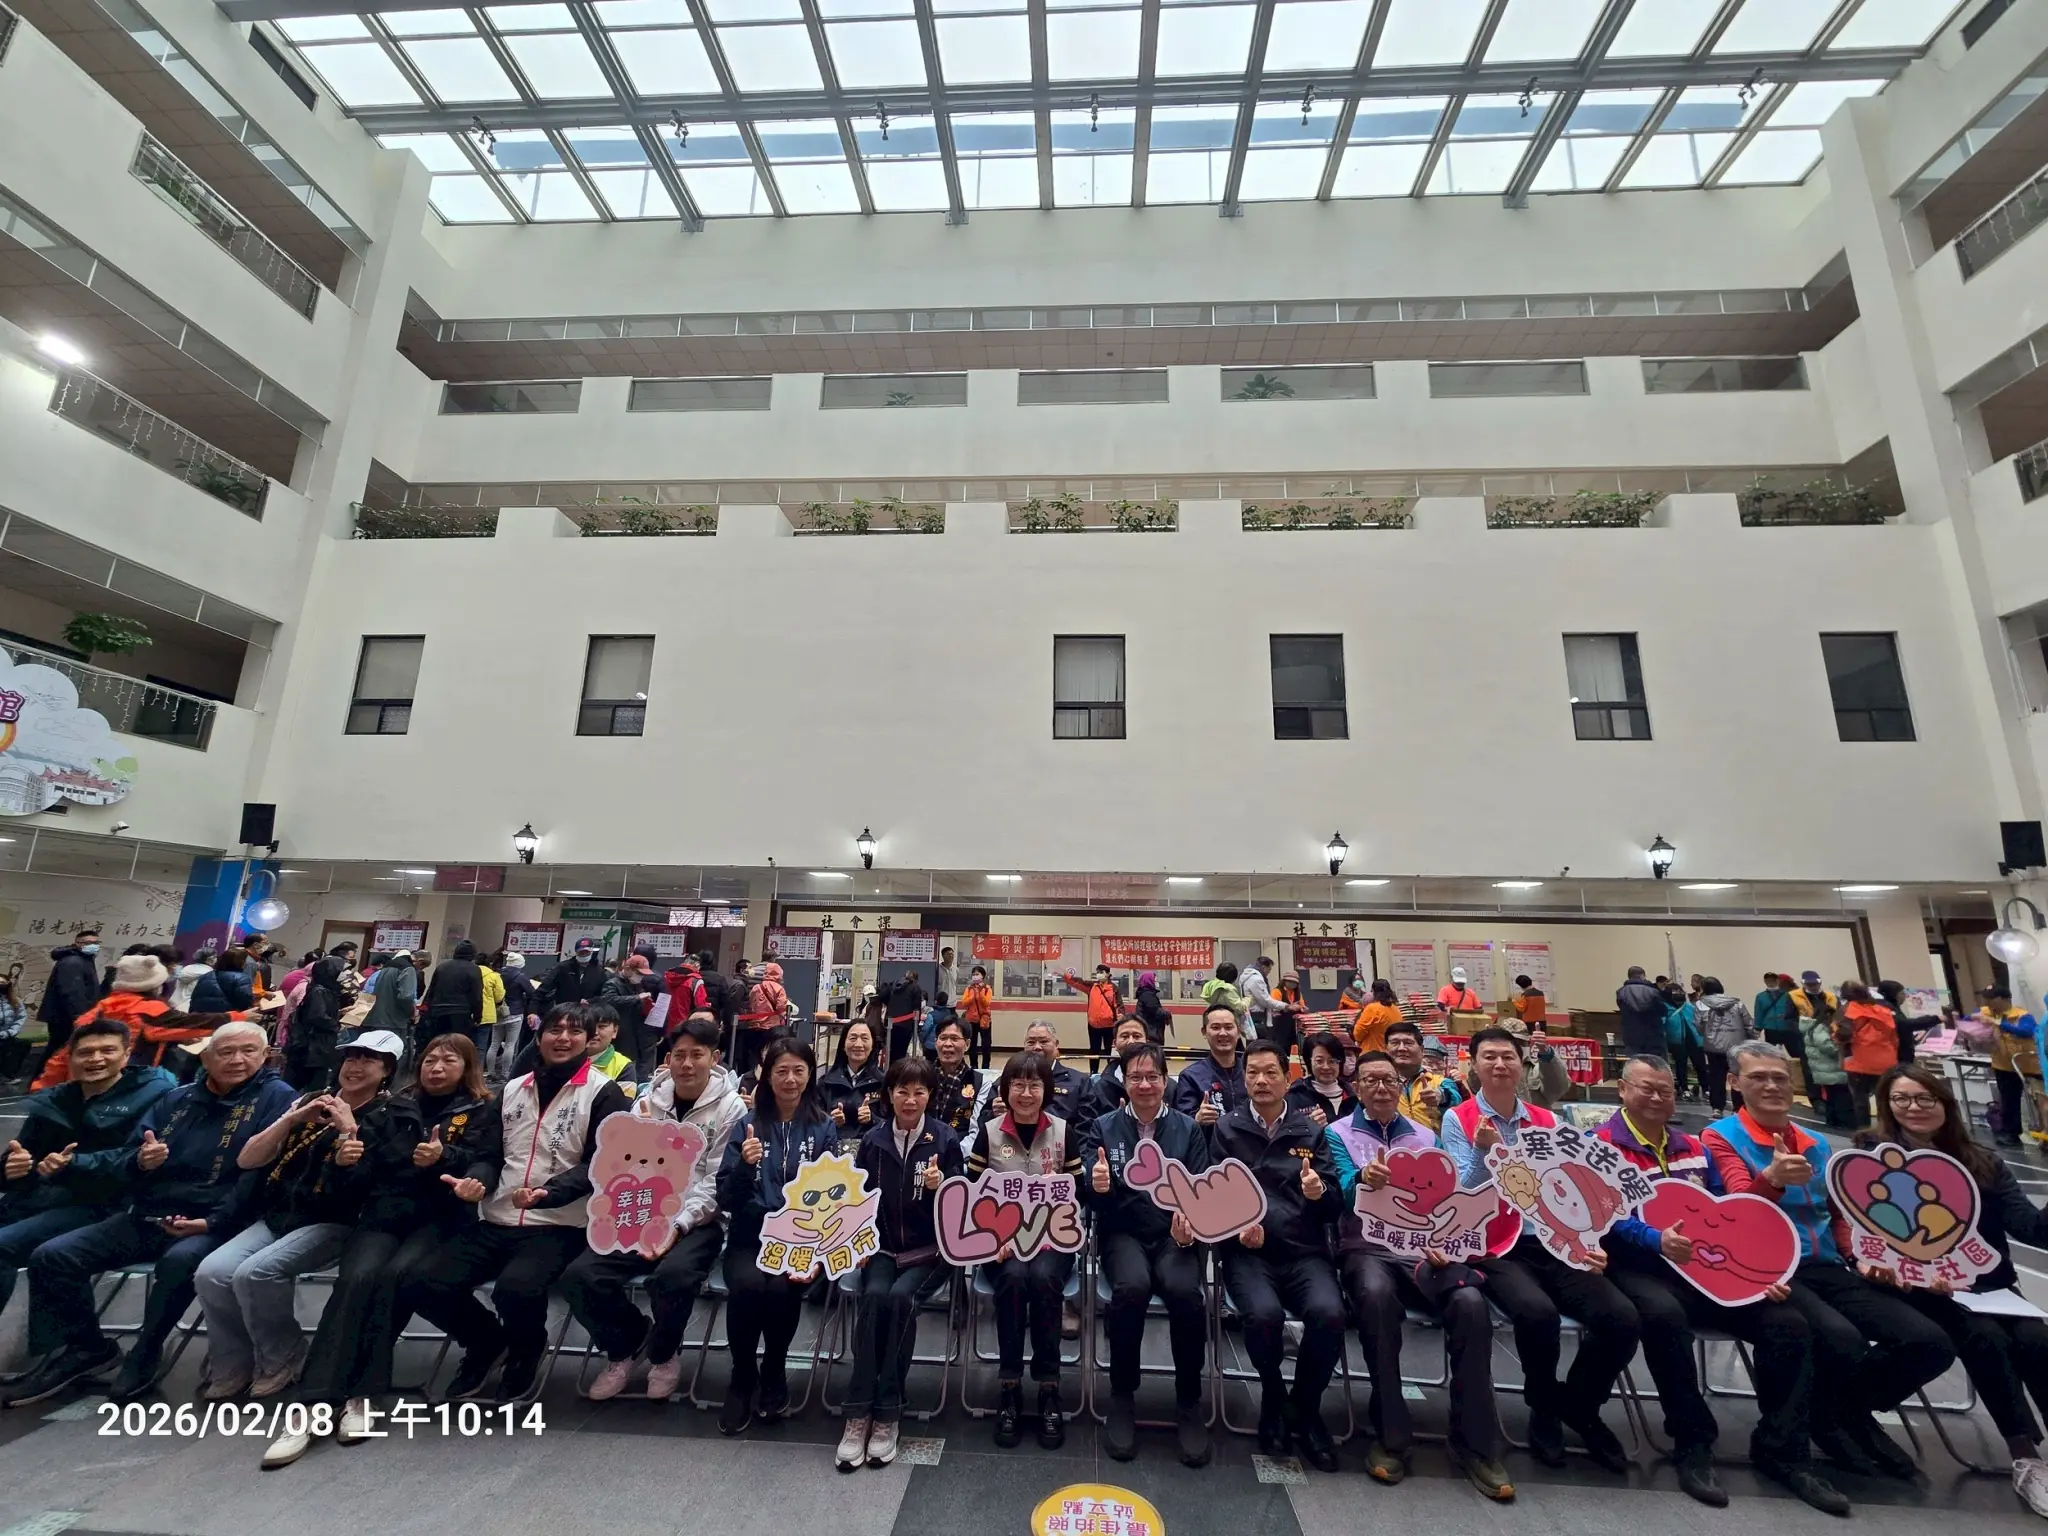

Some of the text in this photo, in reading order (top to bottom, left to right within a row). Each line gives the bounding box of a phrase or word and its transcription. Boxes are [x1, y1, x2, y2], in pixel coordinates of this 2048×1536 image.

[29, 919, 104, 935] 陽光城市
[821, 914, 892, 929] 社會課
[1293, 922, 1358, 937] 社會課
[862, 938, 873, 961] 入口
[1521, 1127, 1653, 1204] 寒冬送暖
[617, 1188, 653, 1208] 幸福
[978, 1176, 1071, 1204] 人間有愛
[616, 1208, 652, 1229] 共享
[760, 1226, 876, 1276] 溫暖同行
[1859, 1235, 1994, 1283] 愛在社區
[1063, 1500, 1134, 1518] 站立點
